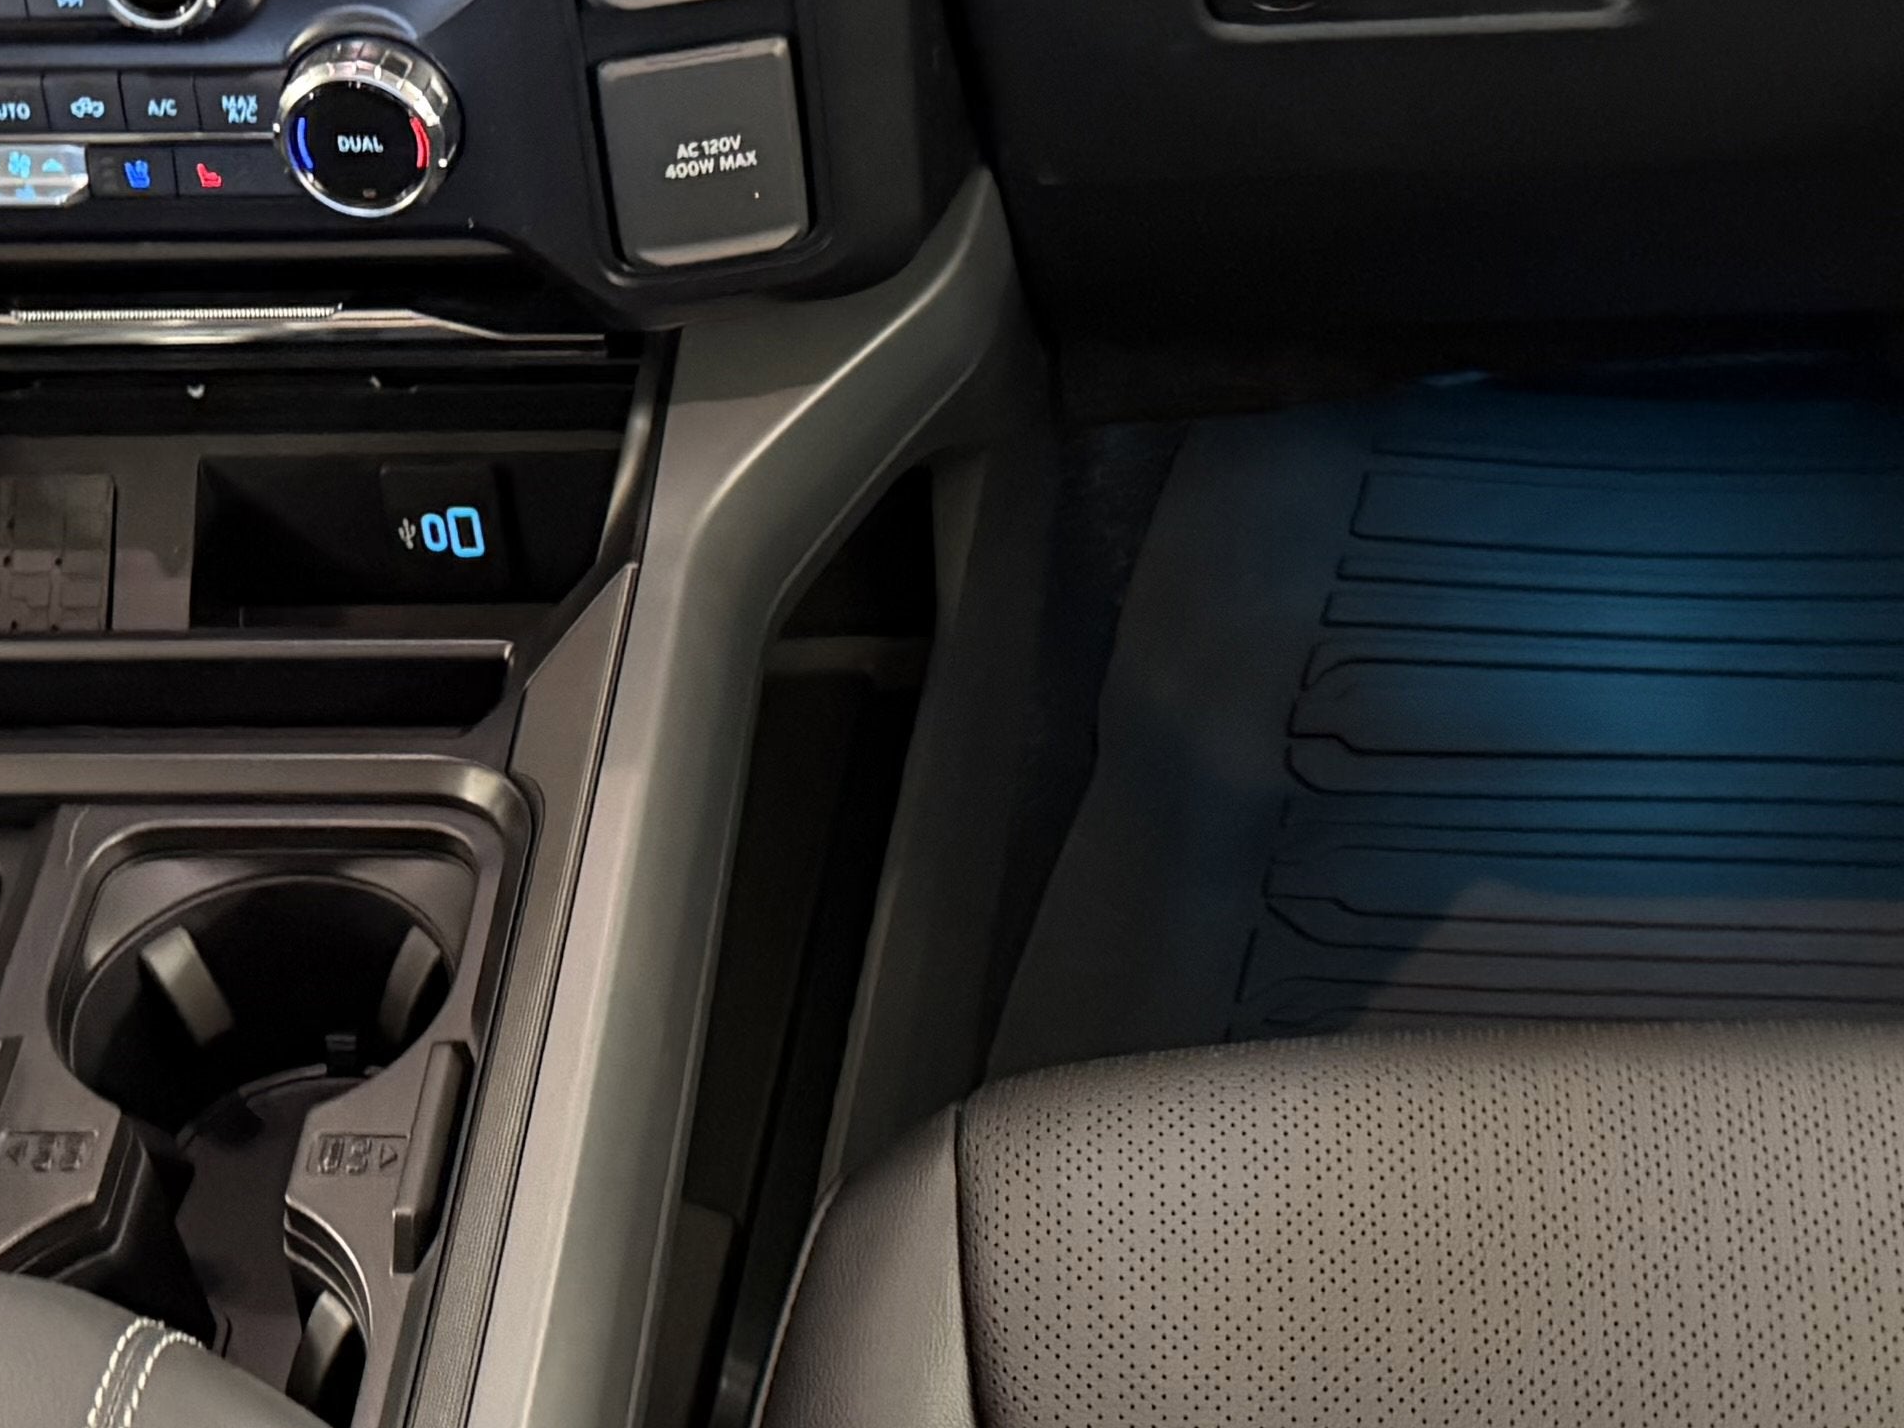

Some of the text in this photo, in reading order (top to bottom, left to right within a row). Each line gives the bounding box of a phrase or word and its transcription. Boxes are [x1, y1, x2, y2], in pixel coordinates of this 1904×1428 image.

[147, 98, 178, 118] A/C
[336, 134, 385, 155] DUAL
[676, 133, 742, 160] AC 120V
[664, 149, 758, 180] 400W MAX
